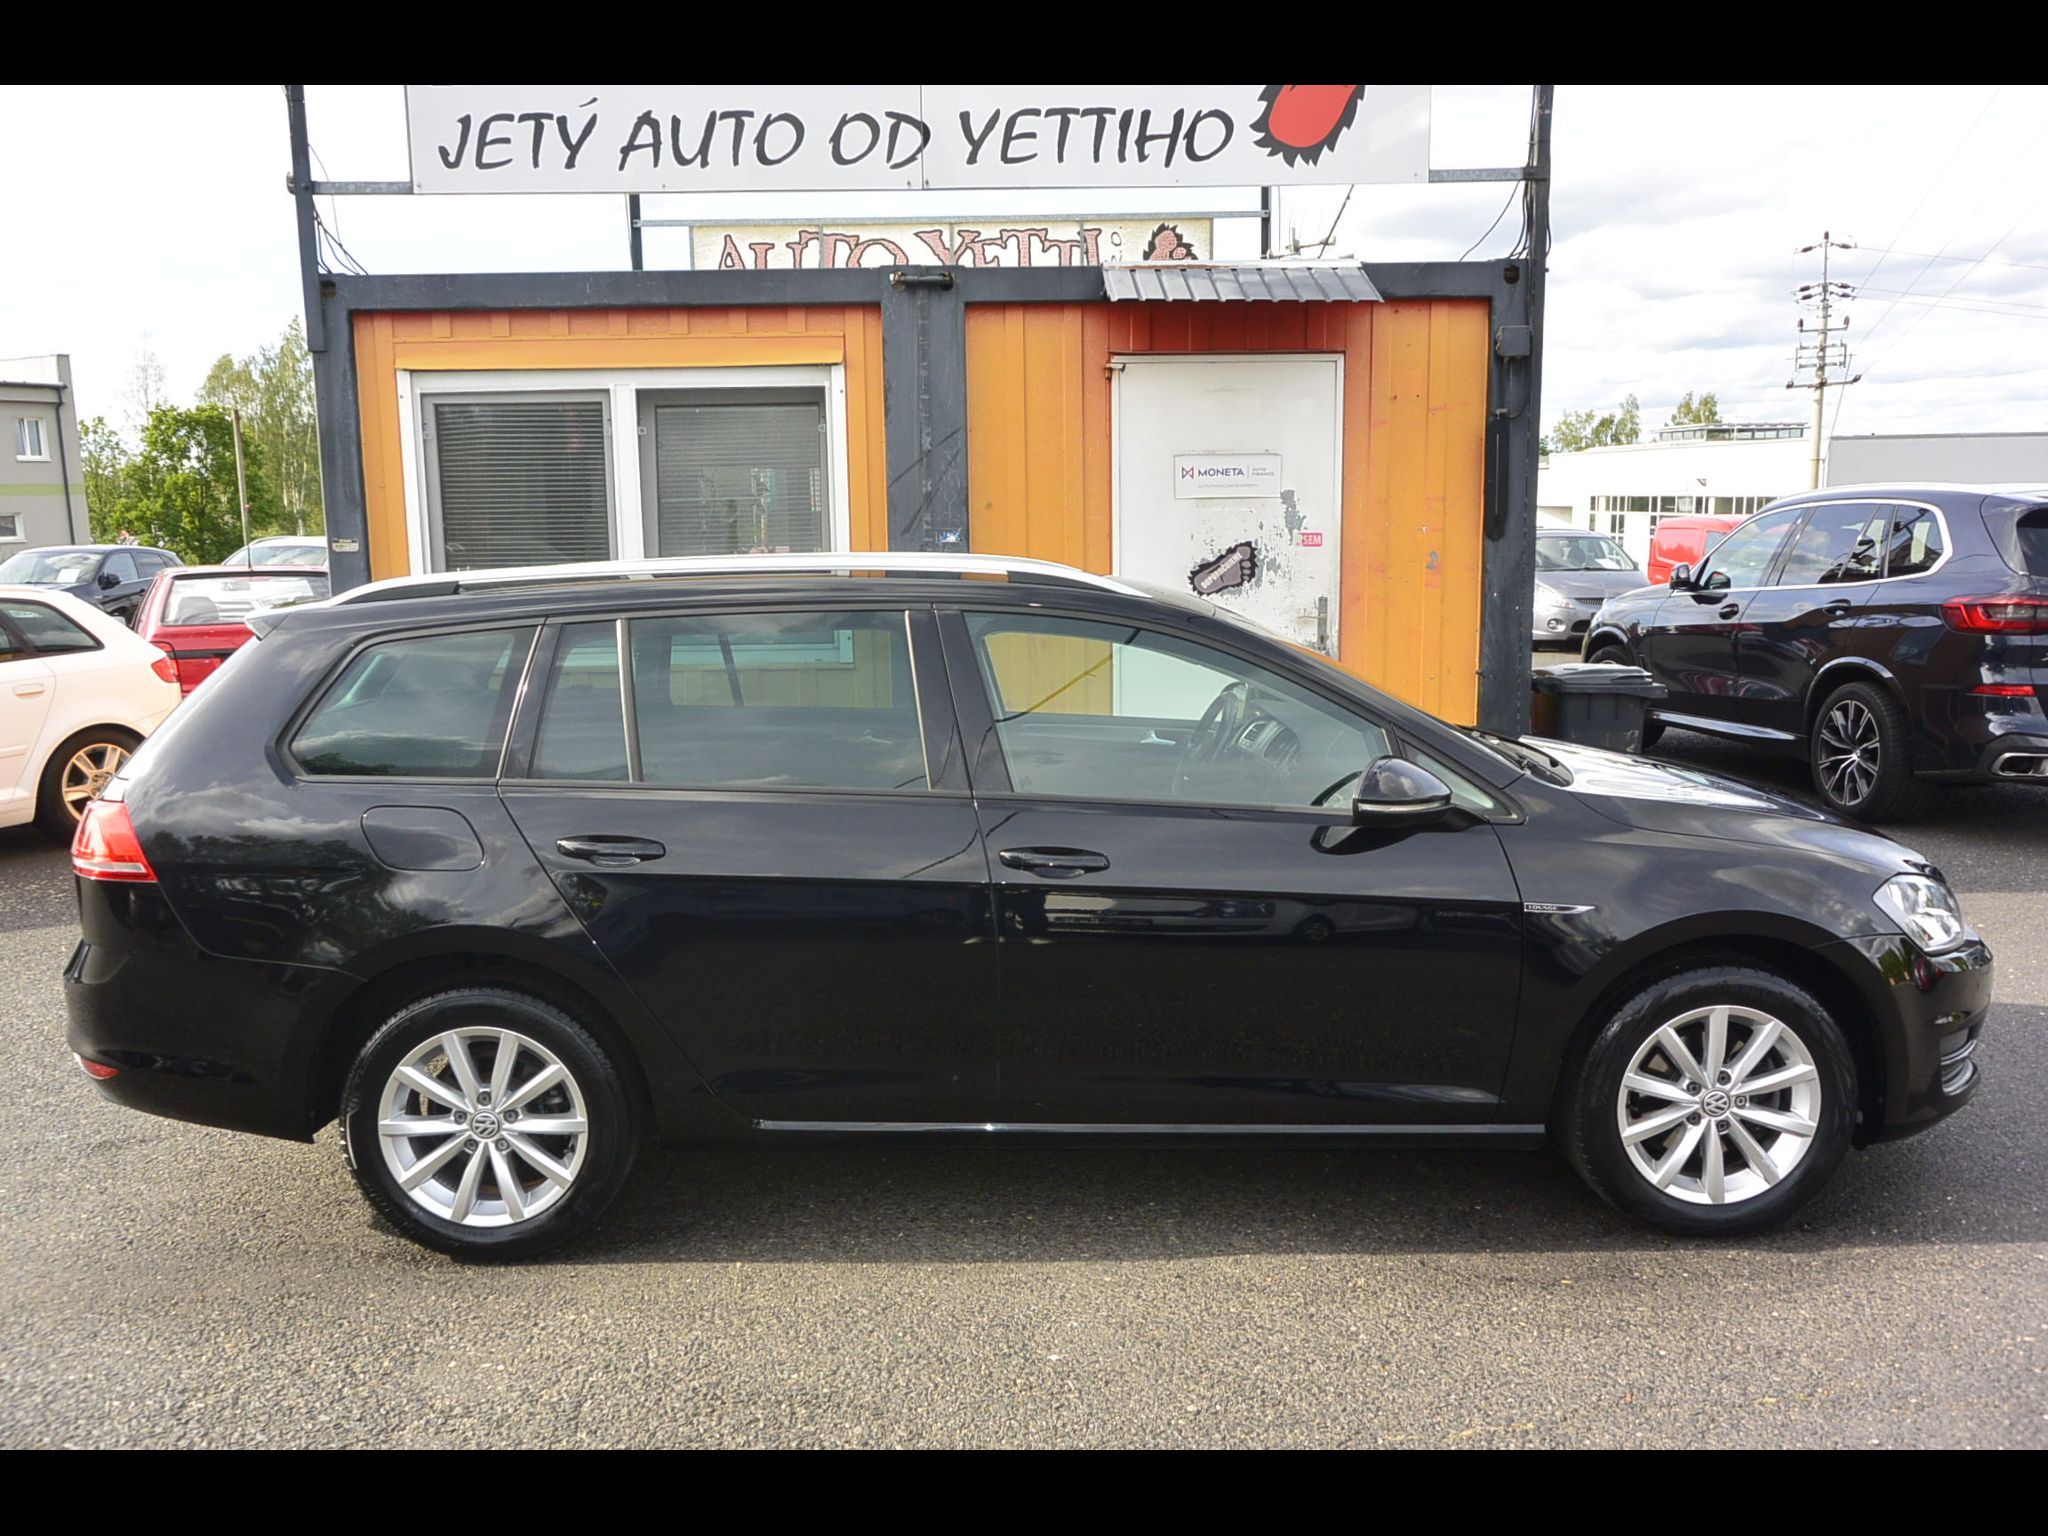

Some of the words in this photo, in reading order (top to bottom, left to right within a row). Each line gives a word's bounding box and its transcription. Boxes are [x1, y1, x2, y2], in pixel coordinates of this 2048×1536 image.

[438, 97, 599, 170] JETÝ
[618, 109, 806, 172] AUTO
[829, 111, 931, 169] OD
[958, 107, 1236, 168] YETTIHO
[1198, 467, 1245, 477] MONETA
[1303, 535, 1322, 546] SEM
